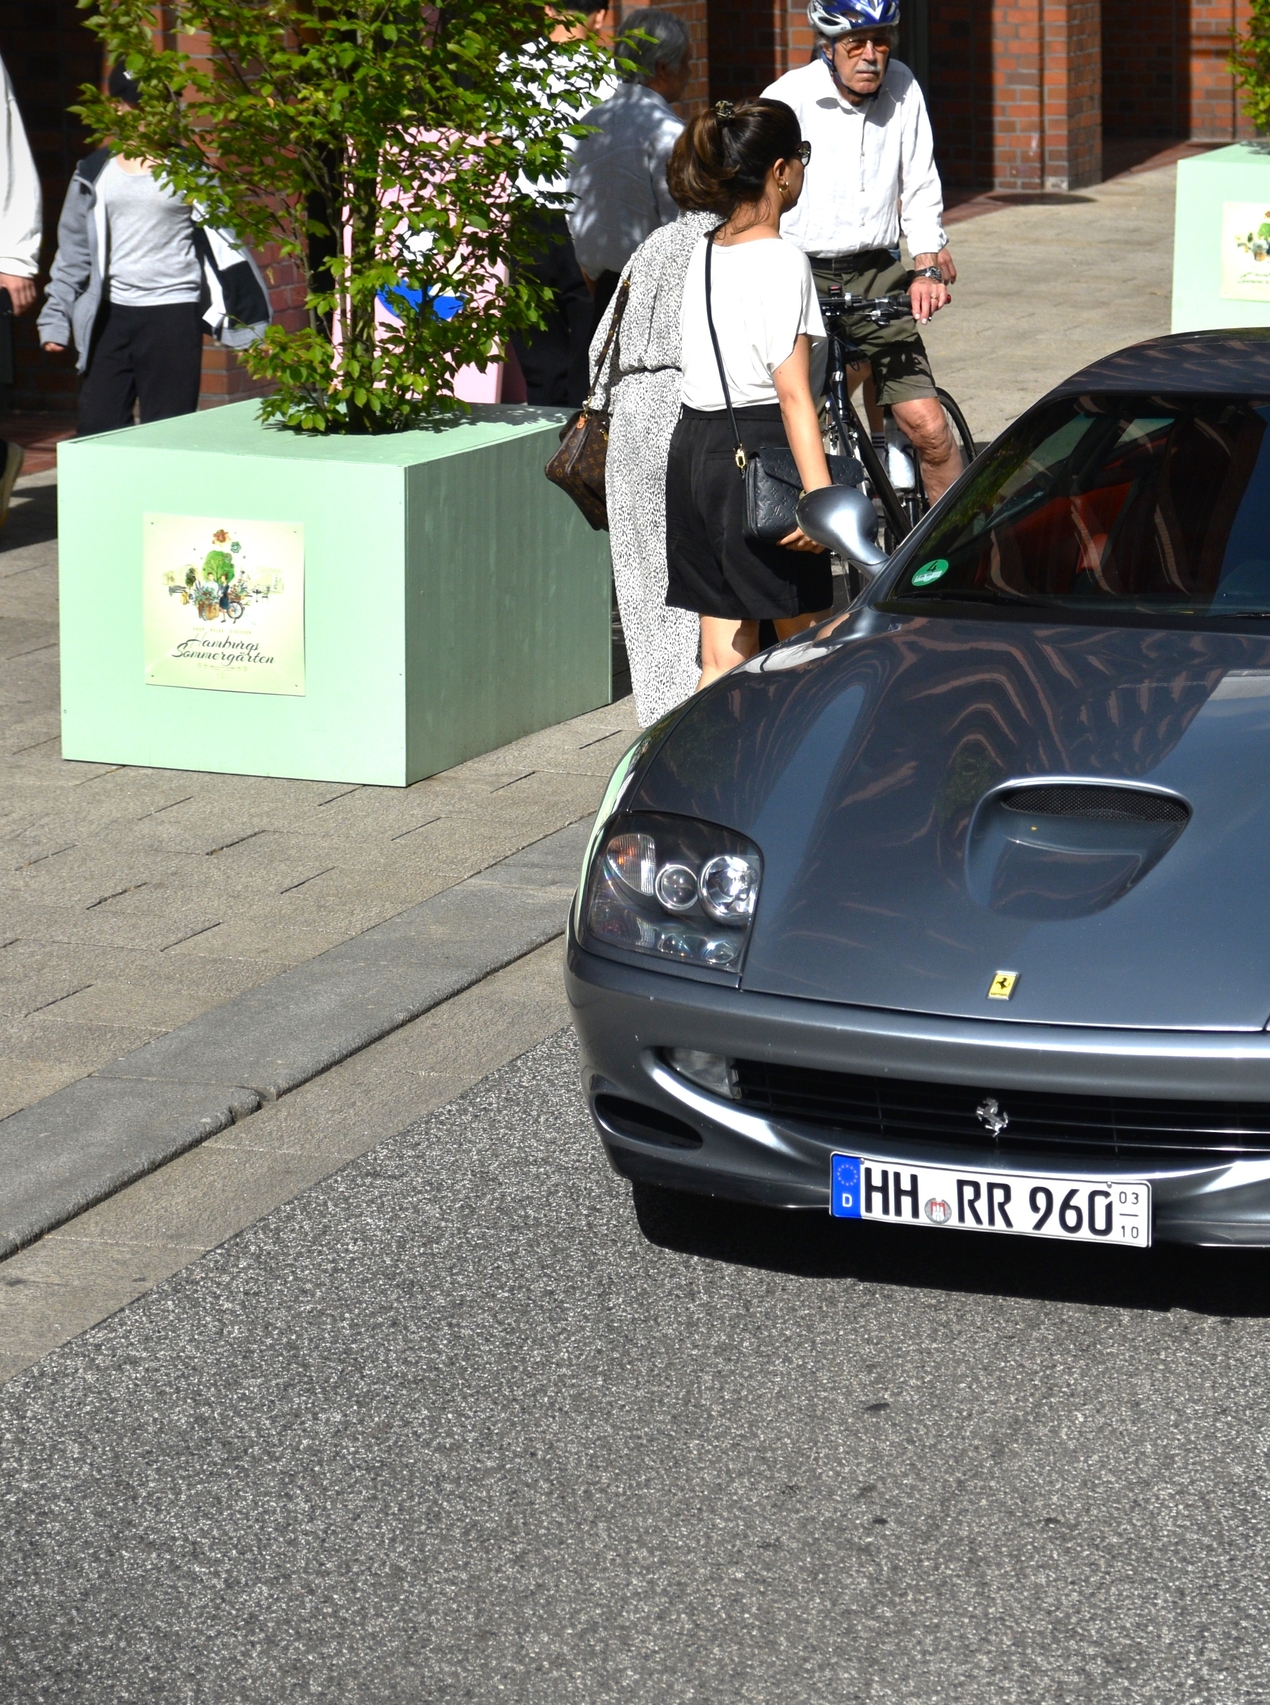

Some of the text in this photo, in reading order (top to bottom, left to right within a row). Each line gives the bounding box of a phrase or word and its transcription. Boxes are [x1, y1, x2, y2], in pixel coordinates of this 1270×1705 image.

[926, 560, 939, 573] 4
[186, 632, 260, 655] Hamburgs
[171, 642, 275, 666] Sommergärten
[841, 1193, 853, 1207] D
[864, 1167, 1113, 1237] HH RR 960
[1119, 1191, 1139, 1205] 03
[1121, 1225, 1139, 1239] 10
